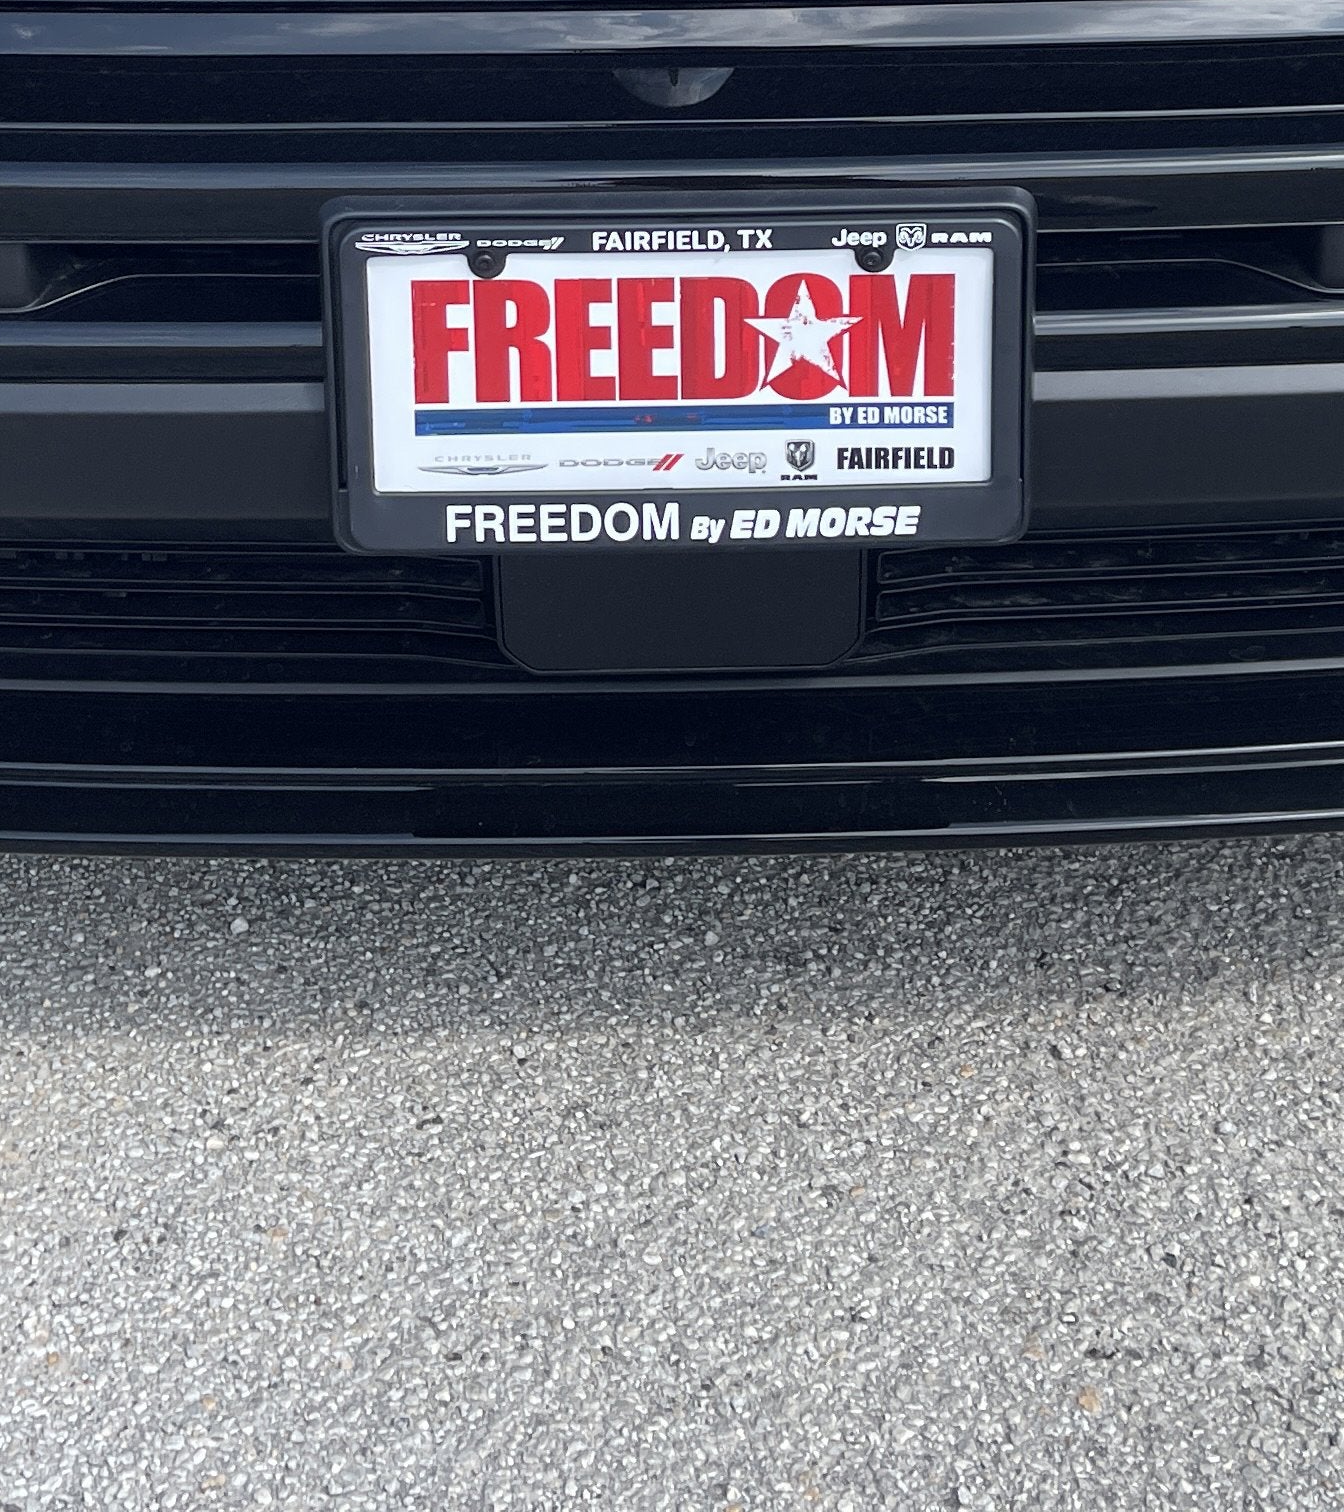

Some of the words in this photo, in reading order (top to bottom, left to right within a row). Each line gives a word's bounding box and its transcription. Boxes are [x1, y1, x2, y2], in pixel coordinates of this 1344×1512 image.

[361, 233, 462, 242] CHRYSLER
[476, 239, 553, 248] DODGE
[592, 230, 731, 253] FAIRFIELD,
[736, 228, 773, 249] TX
[831, 228, 887, 248] Jeep
[930, 231, 992, 244] RAM
[410, 272, 956, 405] FREEDOM
[829, 407, 853, 425] BY
[857, 406, 880, 425] ED
[884, 405, 948, 425] MORSE
[434, 454, 532, 463] CHRYSLER
[559, 458, 661, 468] DODGE
[694, 447, 767, 474] Jeep
[836, 446, 955, 470] FAIRFIELD
[445, 502, 680, 543] FREEDOM
[690, 515, 725, 544] By
[729, 509, 781, 540] ED
[785, 505, 922, 539] MORSE
